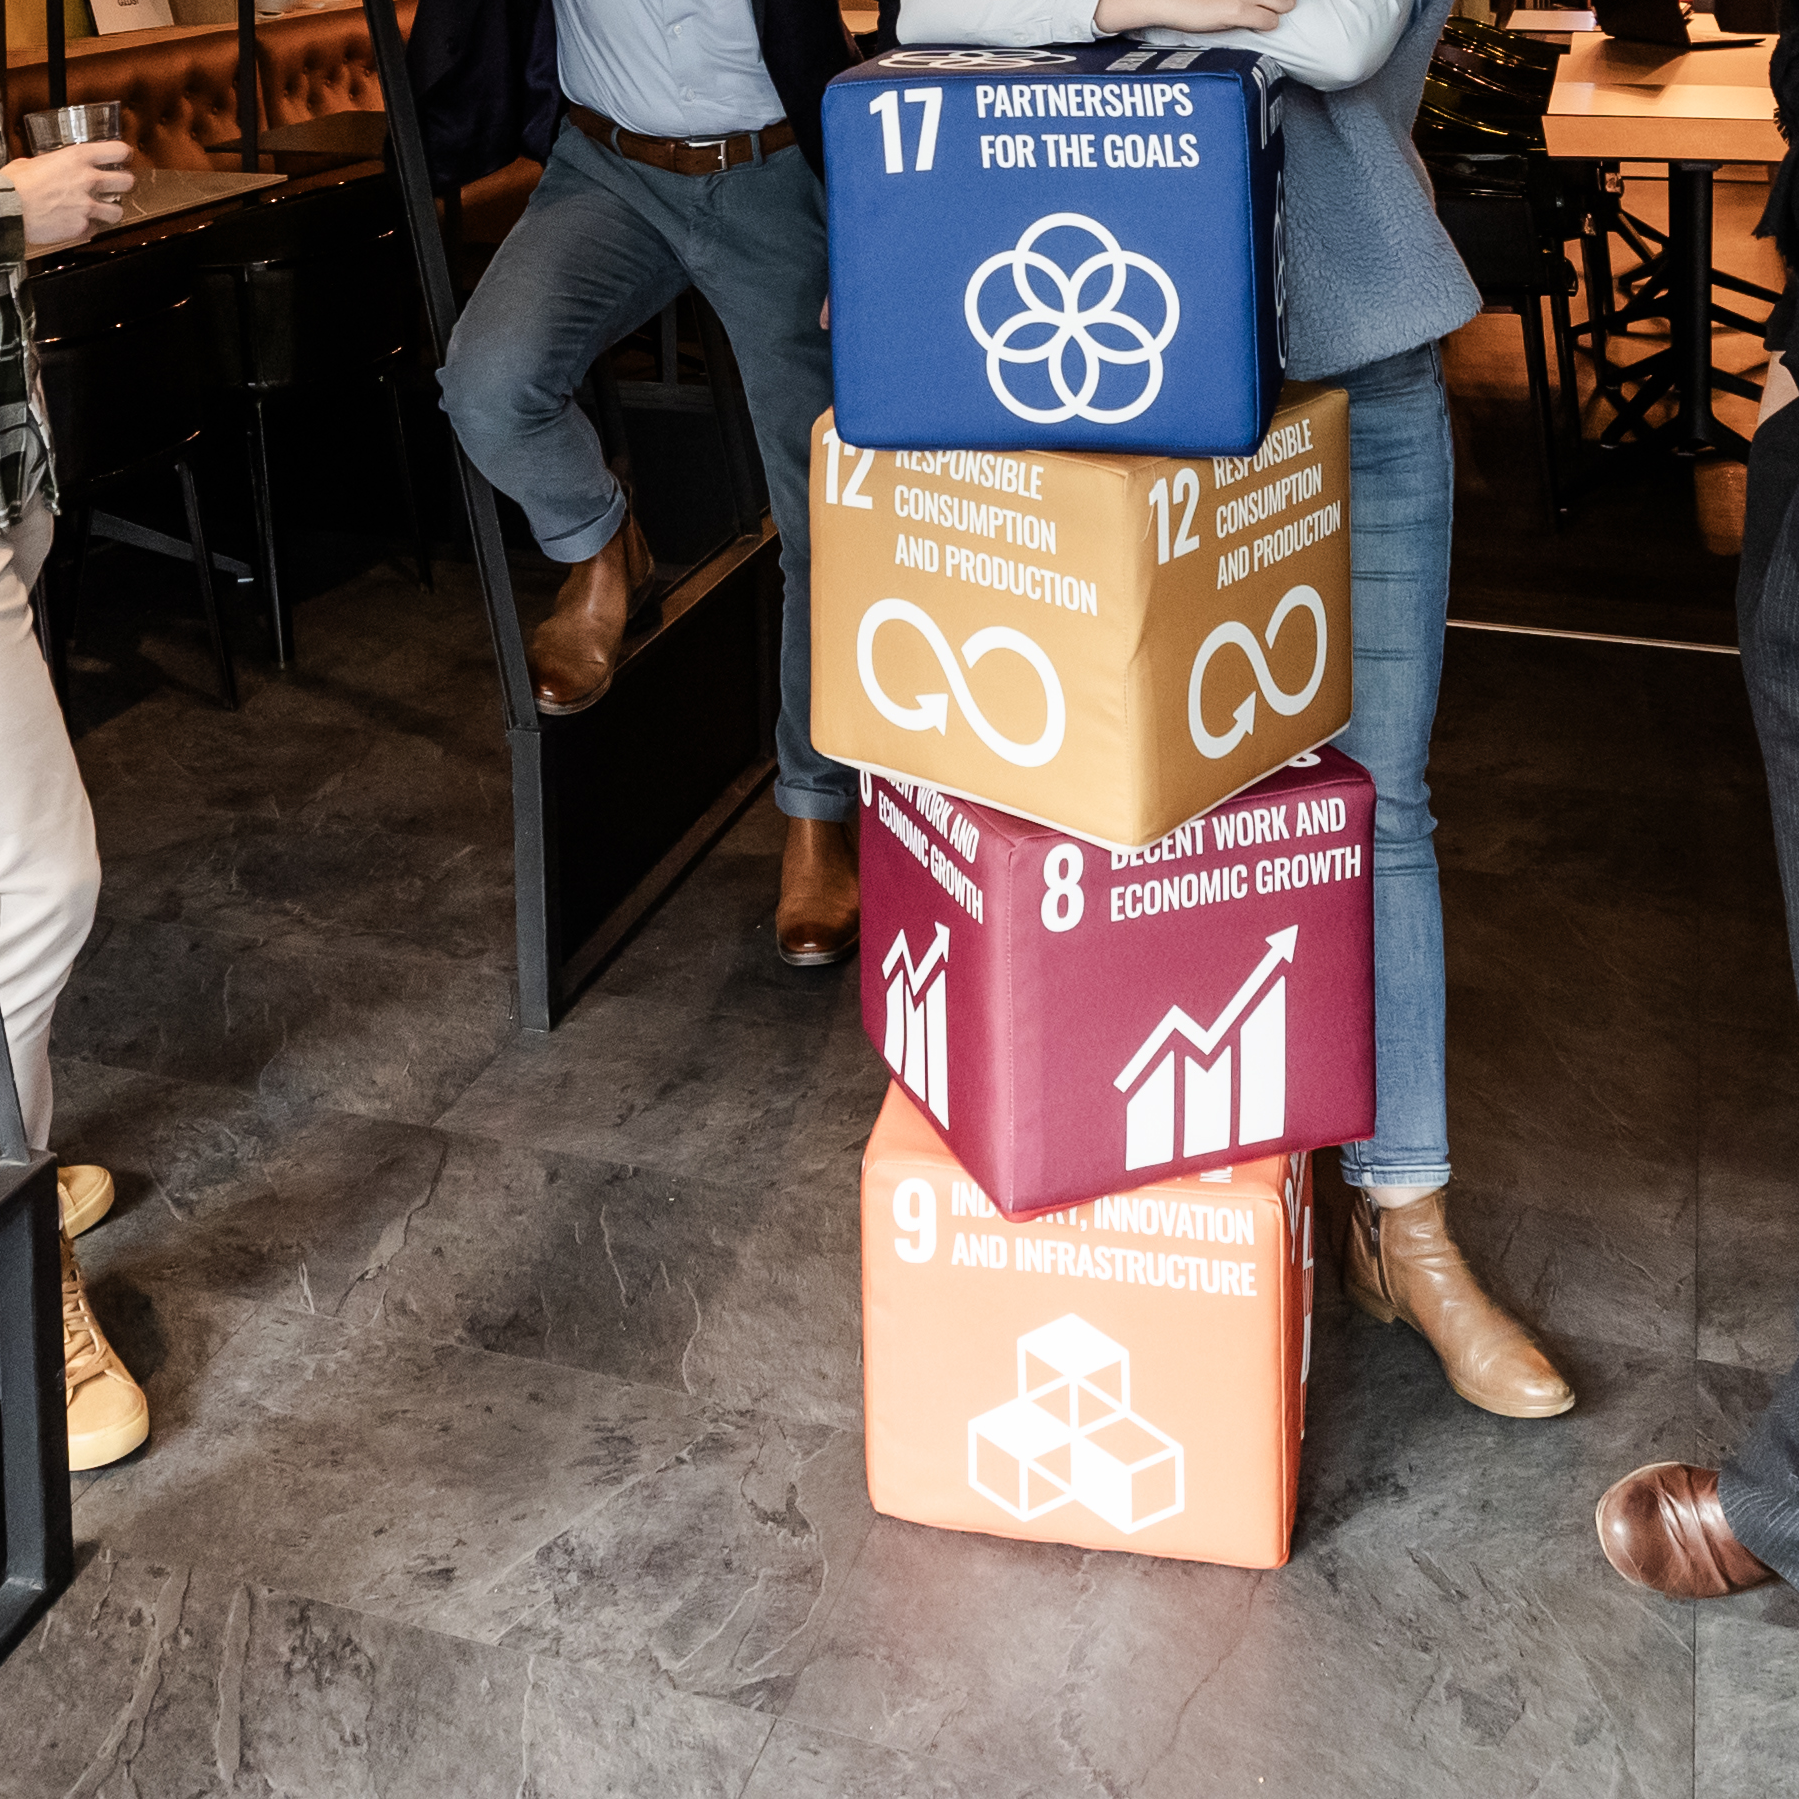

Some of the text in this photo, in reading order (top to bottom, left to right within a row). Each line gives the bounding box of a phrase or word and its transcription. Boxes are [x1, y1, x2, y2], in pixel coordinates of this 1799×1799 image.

[869, 87, 943, 175] 17
[975, 83, 1194, 118] PARTNERSHIPS
[979, 133, 1200, 169] FOR THE GOALS
[822, 427, 875, 510] 12
[1216, 463, 1322, 539] CONSUMPTION
[894, 484, 1057, 555] CONSUMPTION
[1148, 467, 1200, 566] 12
[1216, 499, 1341, 590] AND PRODUCTION
[894, 533, 1098, 617] AND PRODUCTION
[878, 789, 929, 868] ECONOMIC
[930, 843, 983, 925] GROWTH
[915, 786, 954, 840] WORK
[949, 812, 980, 864] AND
[1212, 804, 1291, 851] WORK
[1296, 797, 1347, 838] AND
[1040, 842, 1085, 933] 8
[1110, 844, 1362, 923] ECONOMIC GROWTH
[892, 1177, 937, 1264] 9
[1093, 1196, 1255, 1246] INNOVATION
[951, 1232, 1258, 1297] AND INFRASTRUCTURE
